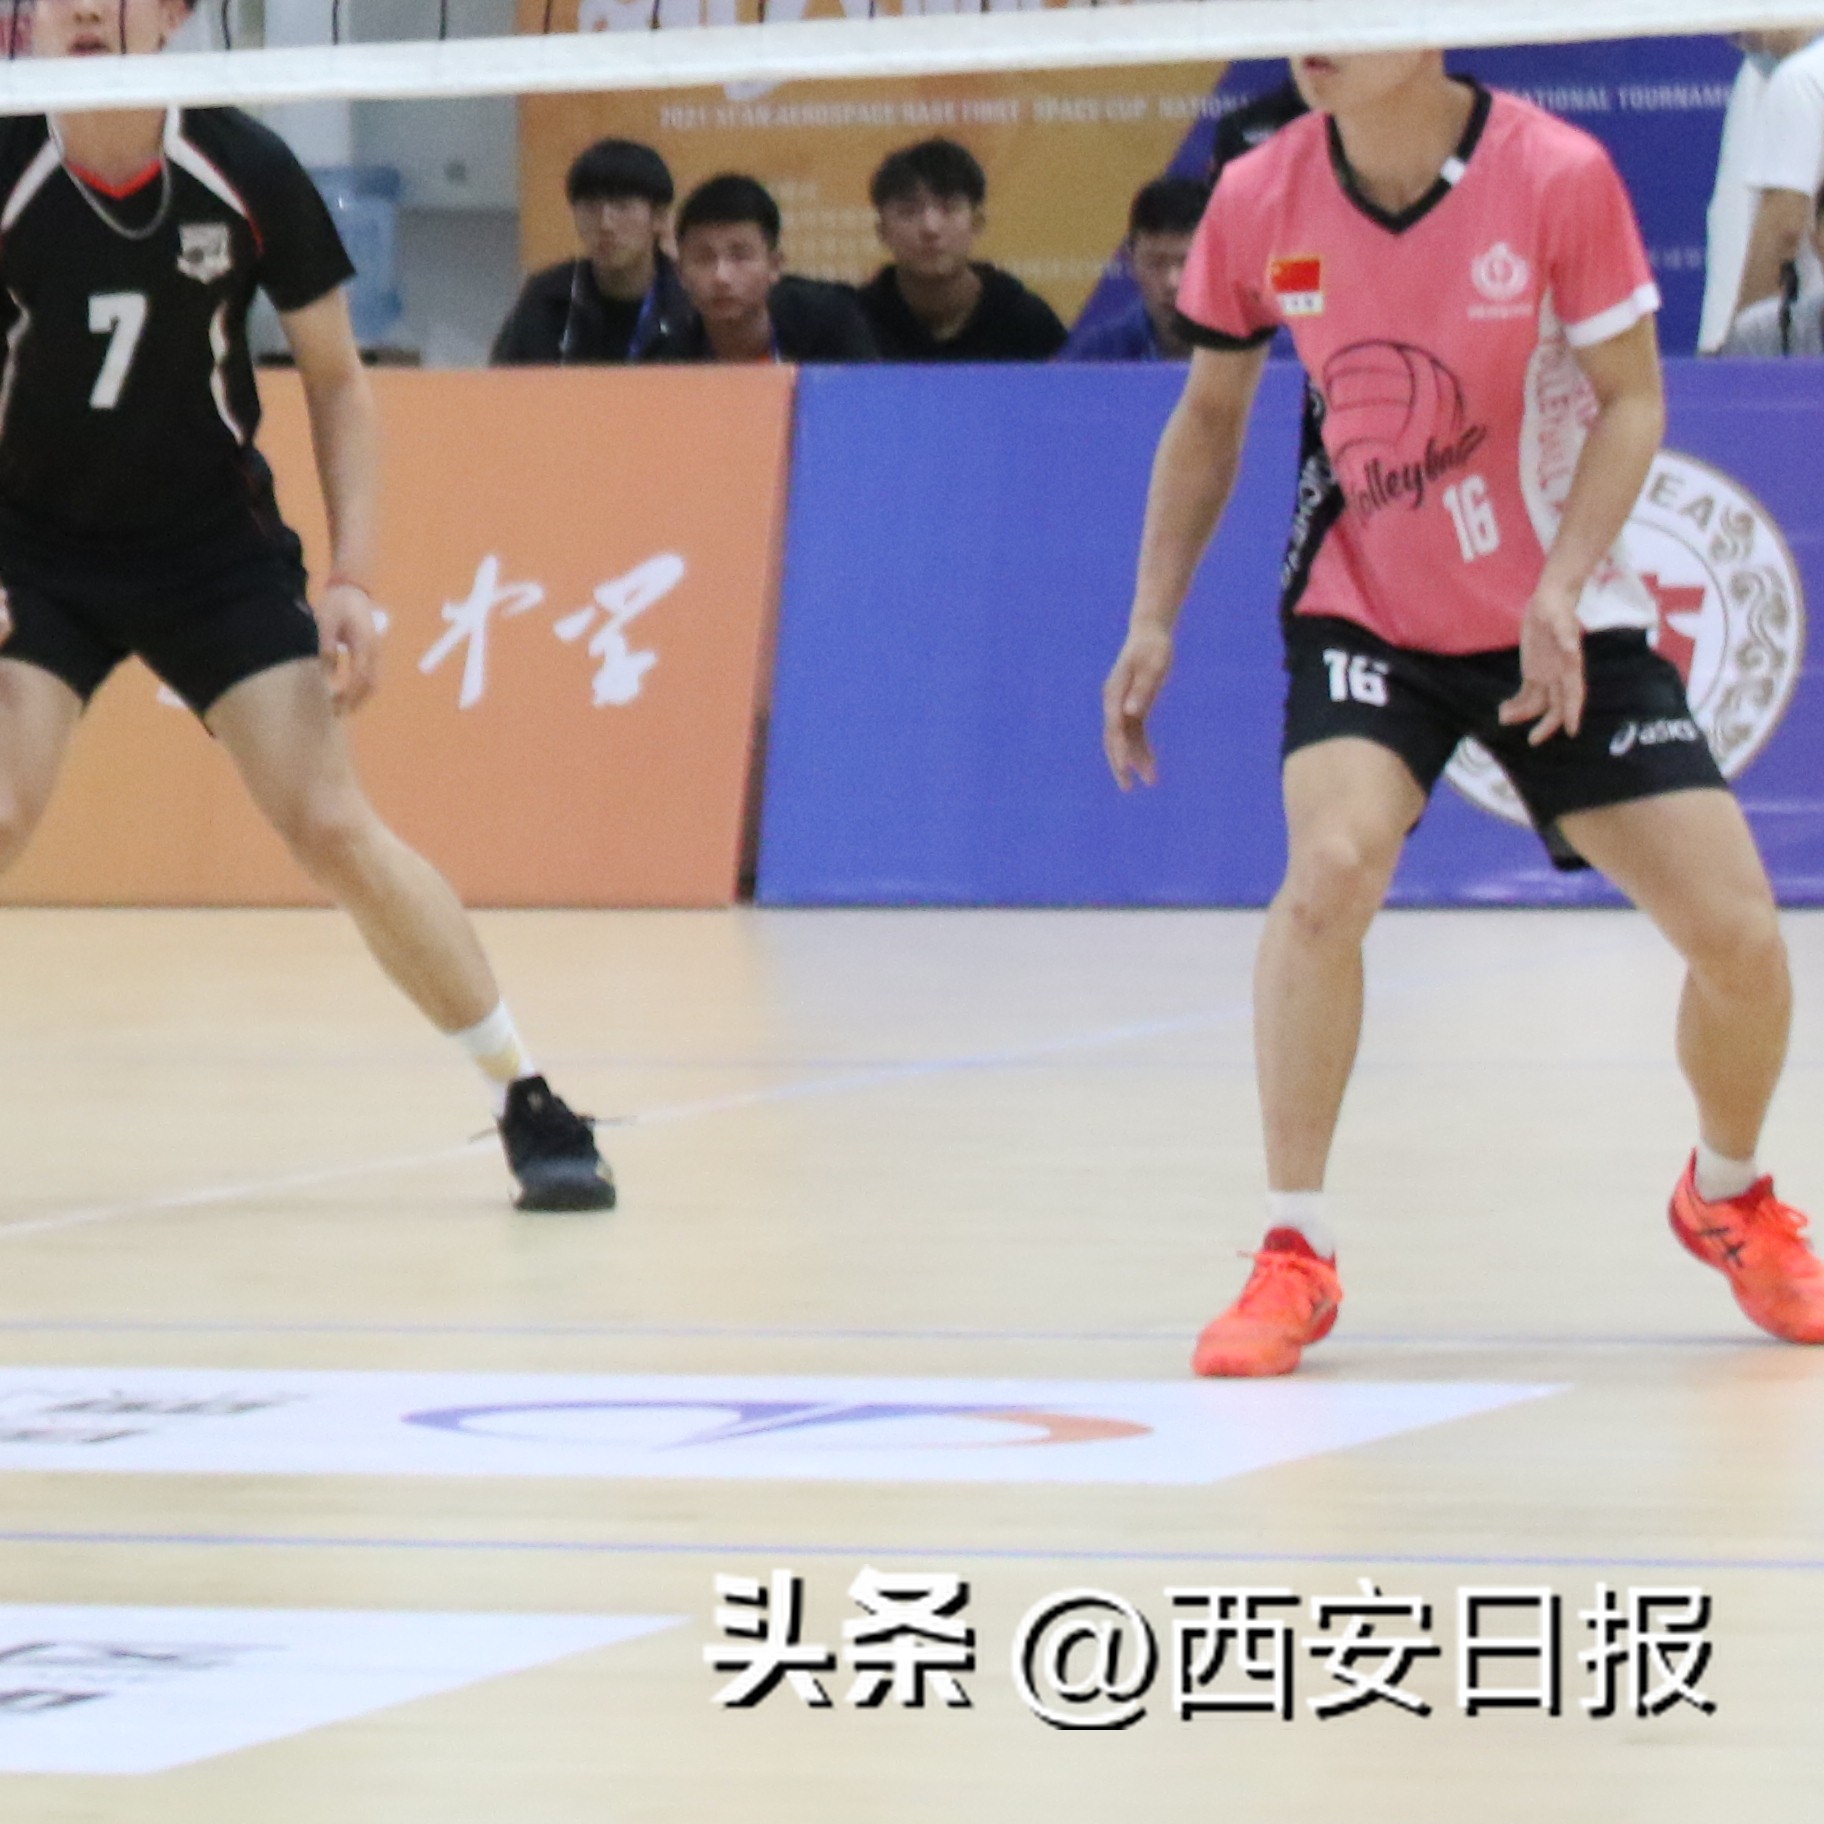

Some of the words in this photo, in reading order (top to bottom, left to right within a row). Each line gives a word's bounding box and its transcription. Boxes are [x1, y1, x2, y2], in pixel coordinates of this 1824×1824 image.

[87, 290, 148, 410] 7
[1442, 474, 1502, 563] 16
[1322, 646, 1390, 708] 16
